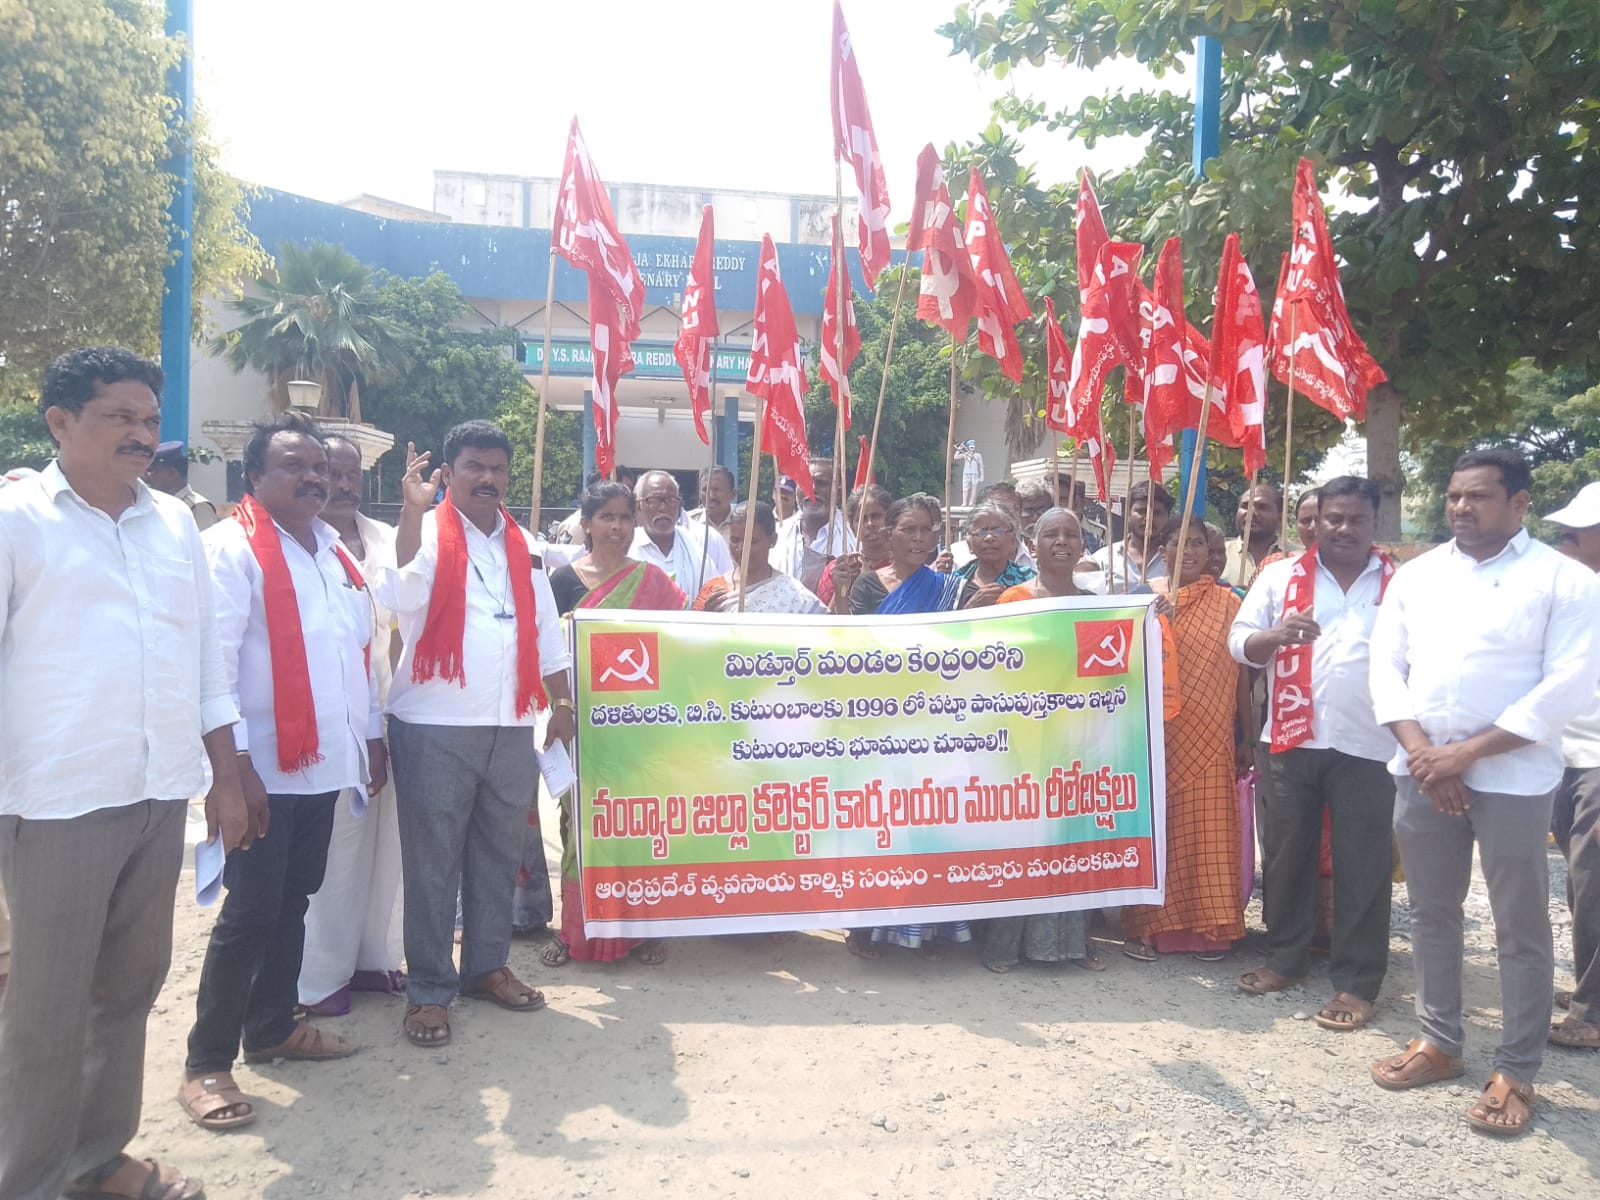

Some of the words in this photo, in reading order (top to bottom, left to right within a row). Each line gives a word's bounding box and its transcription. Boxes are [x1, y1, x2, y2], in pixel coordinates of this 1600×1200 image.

[552, 348, 570, 363] Y.S.
[646, 353, 676, 367] REDDY
[737, 356, 751, 370] HA
[817, 650, 903, 677] మండల
[907, 641, 1024, 680] కేంద్రంలోని
[731, 699, 844, 724] కుటుంబాలకు
[847, 697, 899, 719] 1996
[903, 691, 926, 716] లో
[929, 692, 967, 722] పట్టా
[732, 737, 845, 762] కుటుంబాలకు
[849, 733, 929, 761] భూములు
[592, 787, 687, 859] నంద్యాల
[693, 794, 749, 849] జిల్లా
[753, 775, 829, 855] కలెక్టర్
[964, 772, 1040, 825] ముందు
[595, 872, 697, 905] ఆంధ్రప్రదేశ్
[701, 872, 795, 904] వ్యవసాయ
[799, 870, 854, 899] కార్మిక
[859, 866, 928, 890] సంఘం
